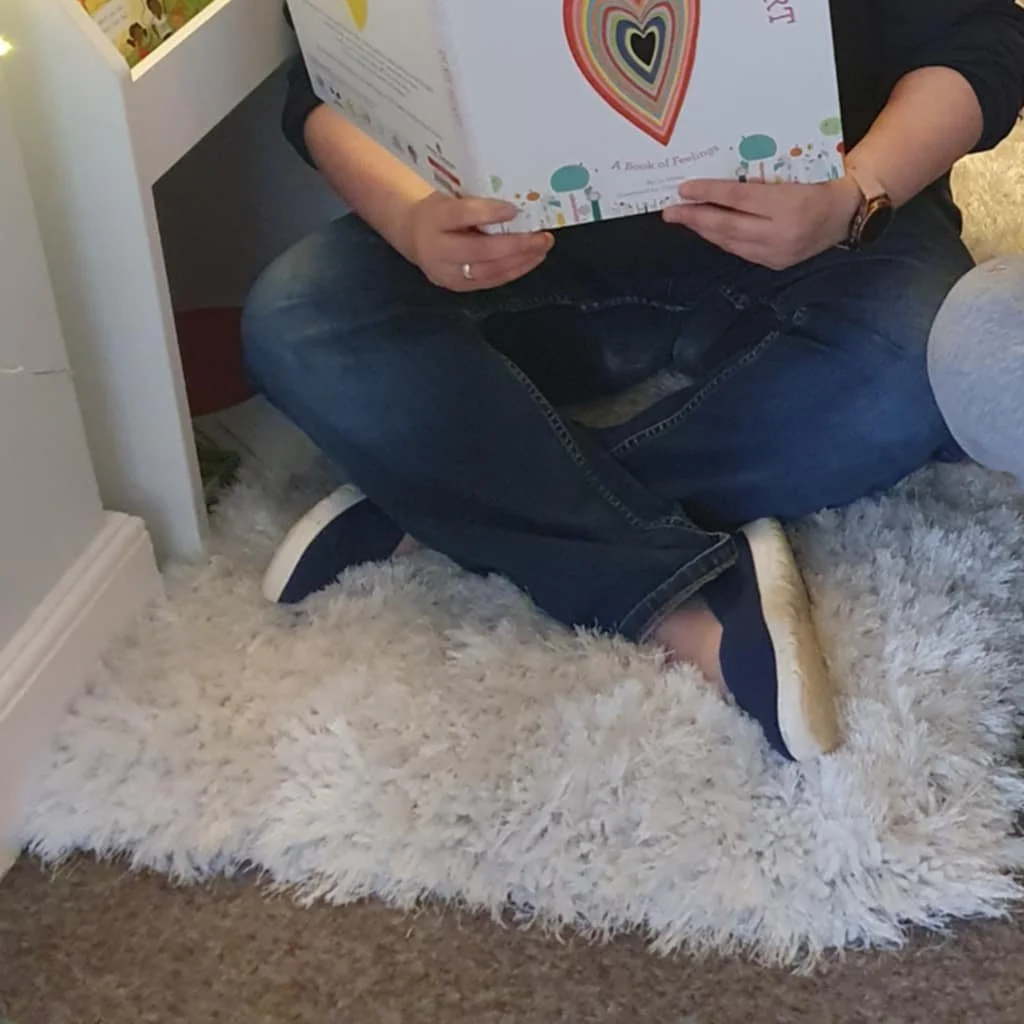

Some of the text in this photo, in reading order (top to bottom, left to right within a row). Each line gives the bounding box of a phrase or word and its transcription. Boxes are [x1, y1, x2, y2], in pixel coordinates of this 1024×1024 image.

[610, 145, 720, 171] A Book of Feelings
